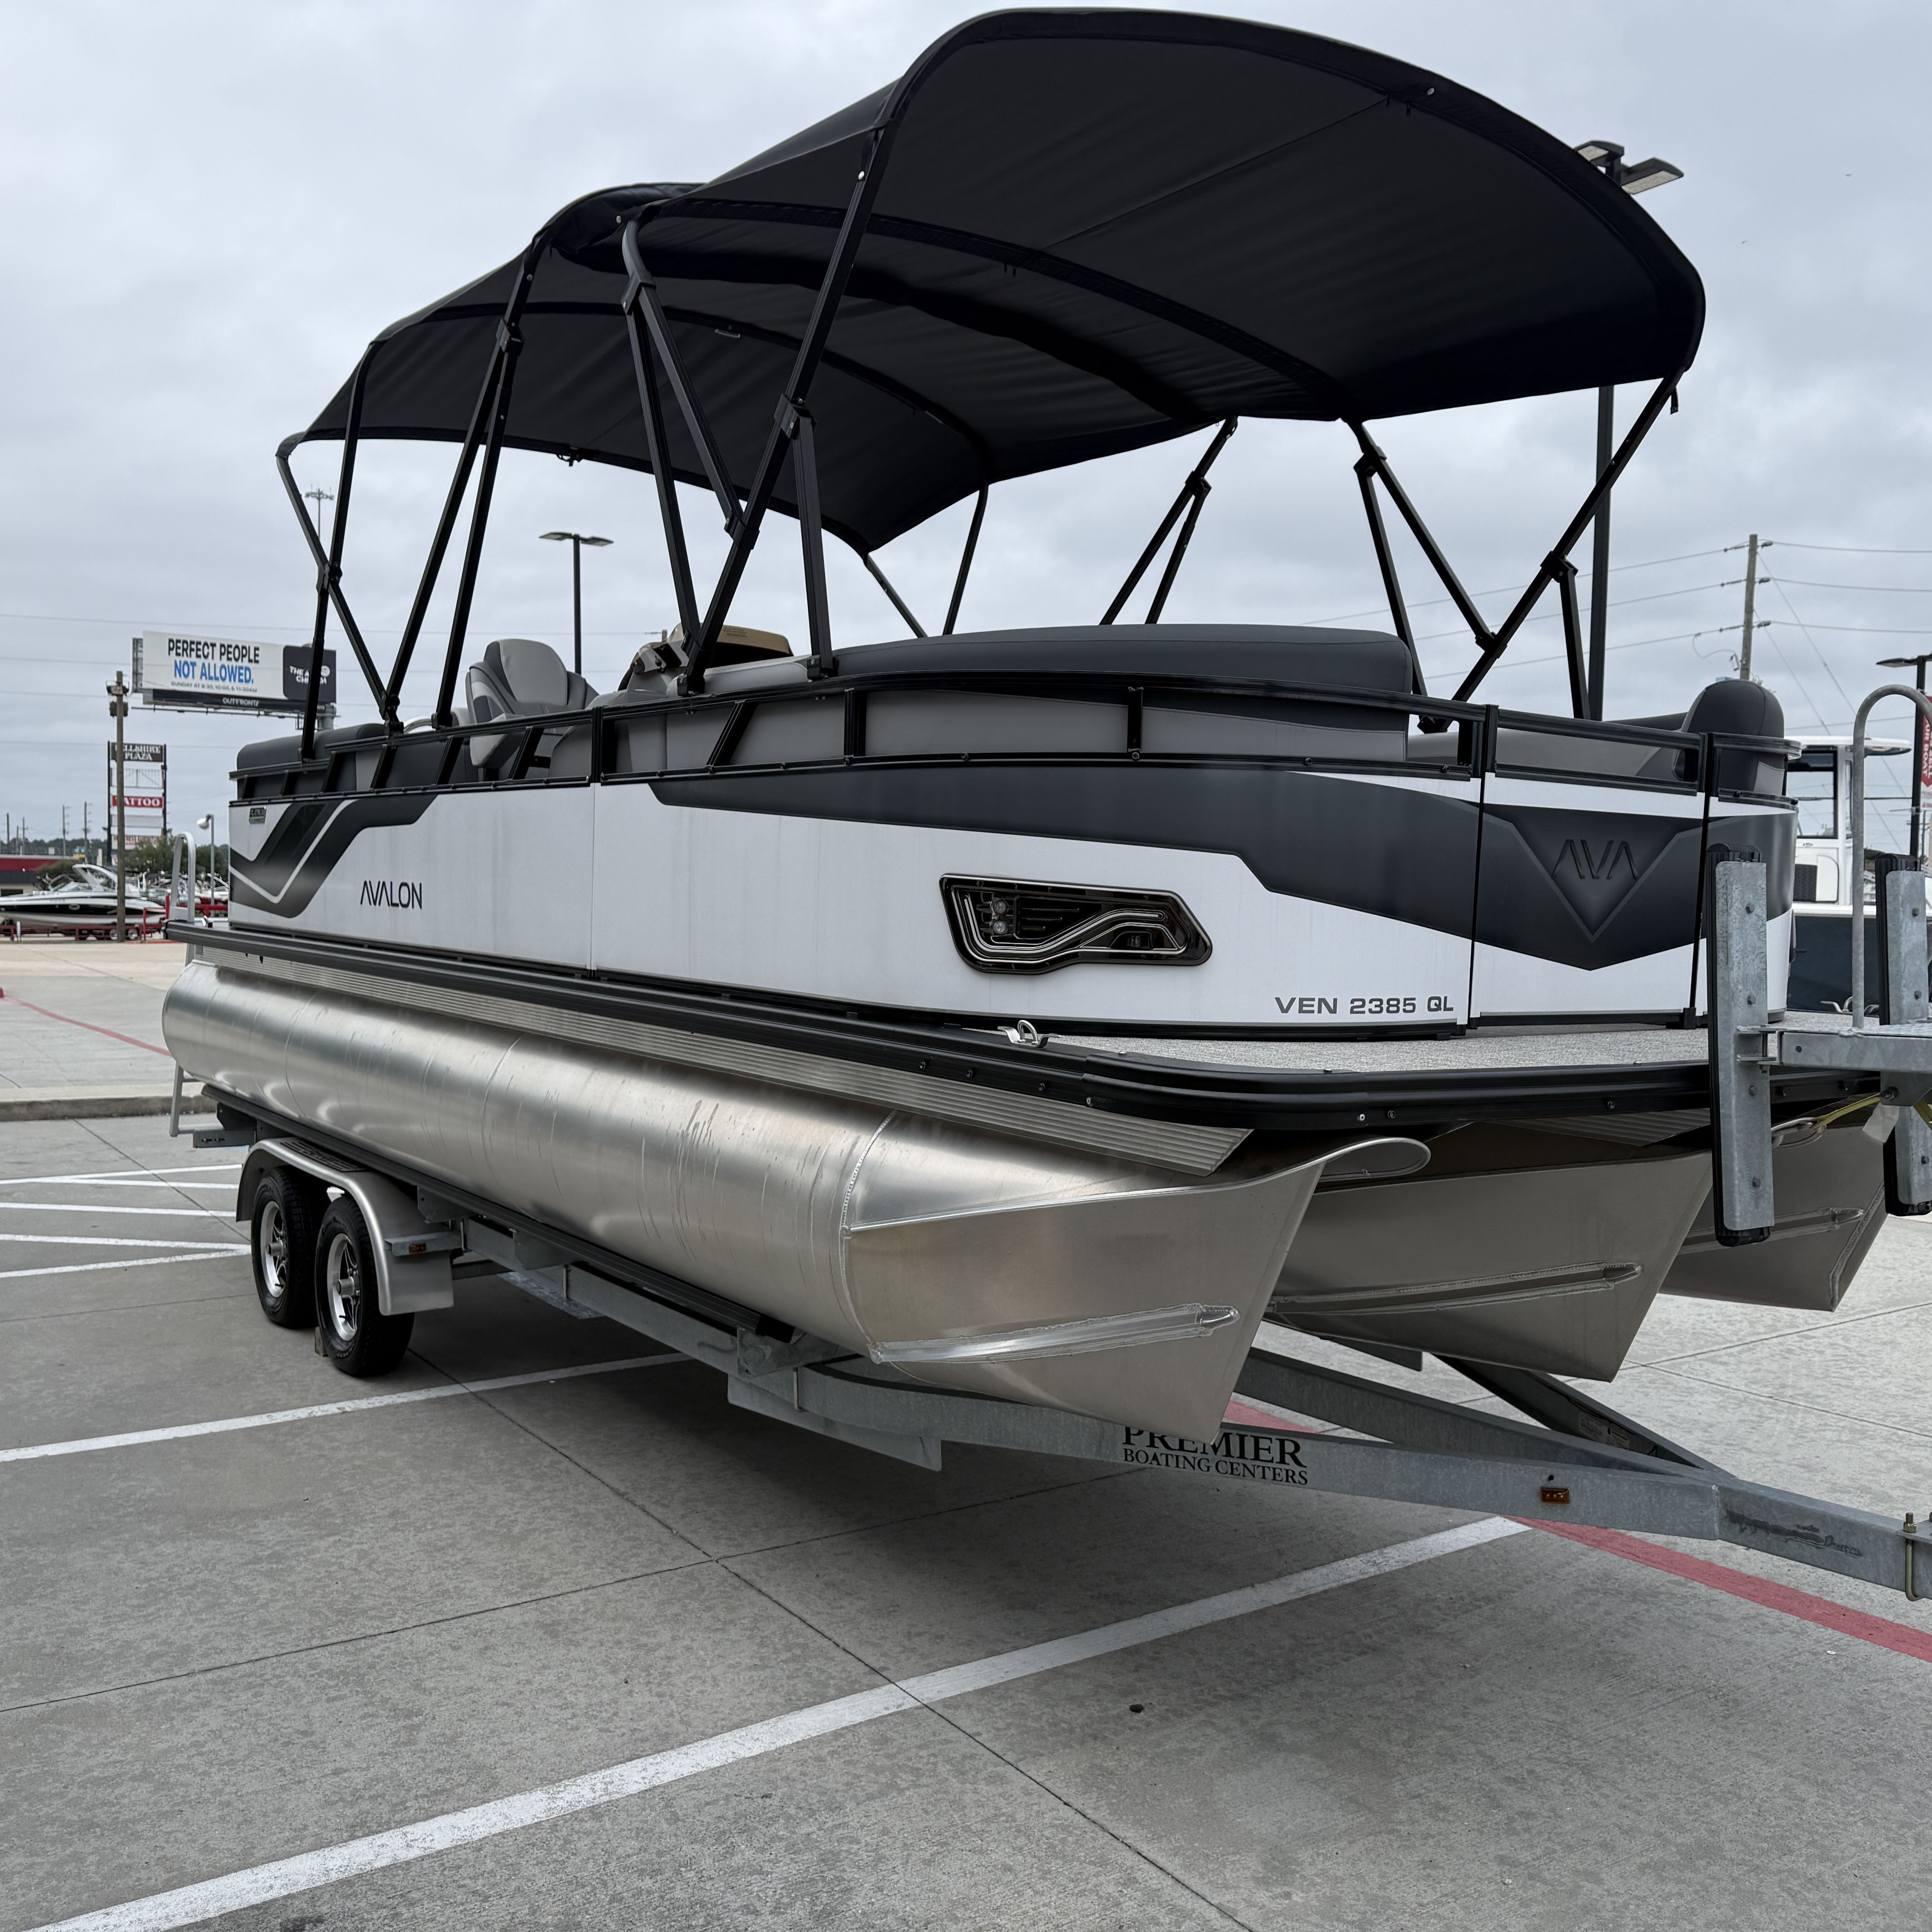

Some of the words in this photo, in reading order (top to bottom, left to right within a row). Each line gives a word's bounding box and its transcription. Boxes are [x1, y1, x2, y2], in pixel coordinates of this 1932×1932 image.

[168, 638, 216, 660] PERFECT
[220, 643, 260, 663] PEOPLE
[174, 659, 196, 679] NOT
[200, 662, 254, 684] ALLOWED.
[290, 666, 304, 676] THE
[125, 752, 152, 761] PLAZA
[115, 797, 160, 806] ATTOO
[360, 880, 422, 910] AVALON
[1274, 997, 1338, 1014] VEN
[1350, 997, 1416, 1014] 2385
[1427, 995, 1454, 1012] QL
[1123, 1448, 1212, 1472] BOATING
[1214, 1459, 1308, 1485] CENTERS
